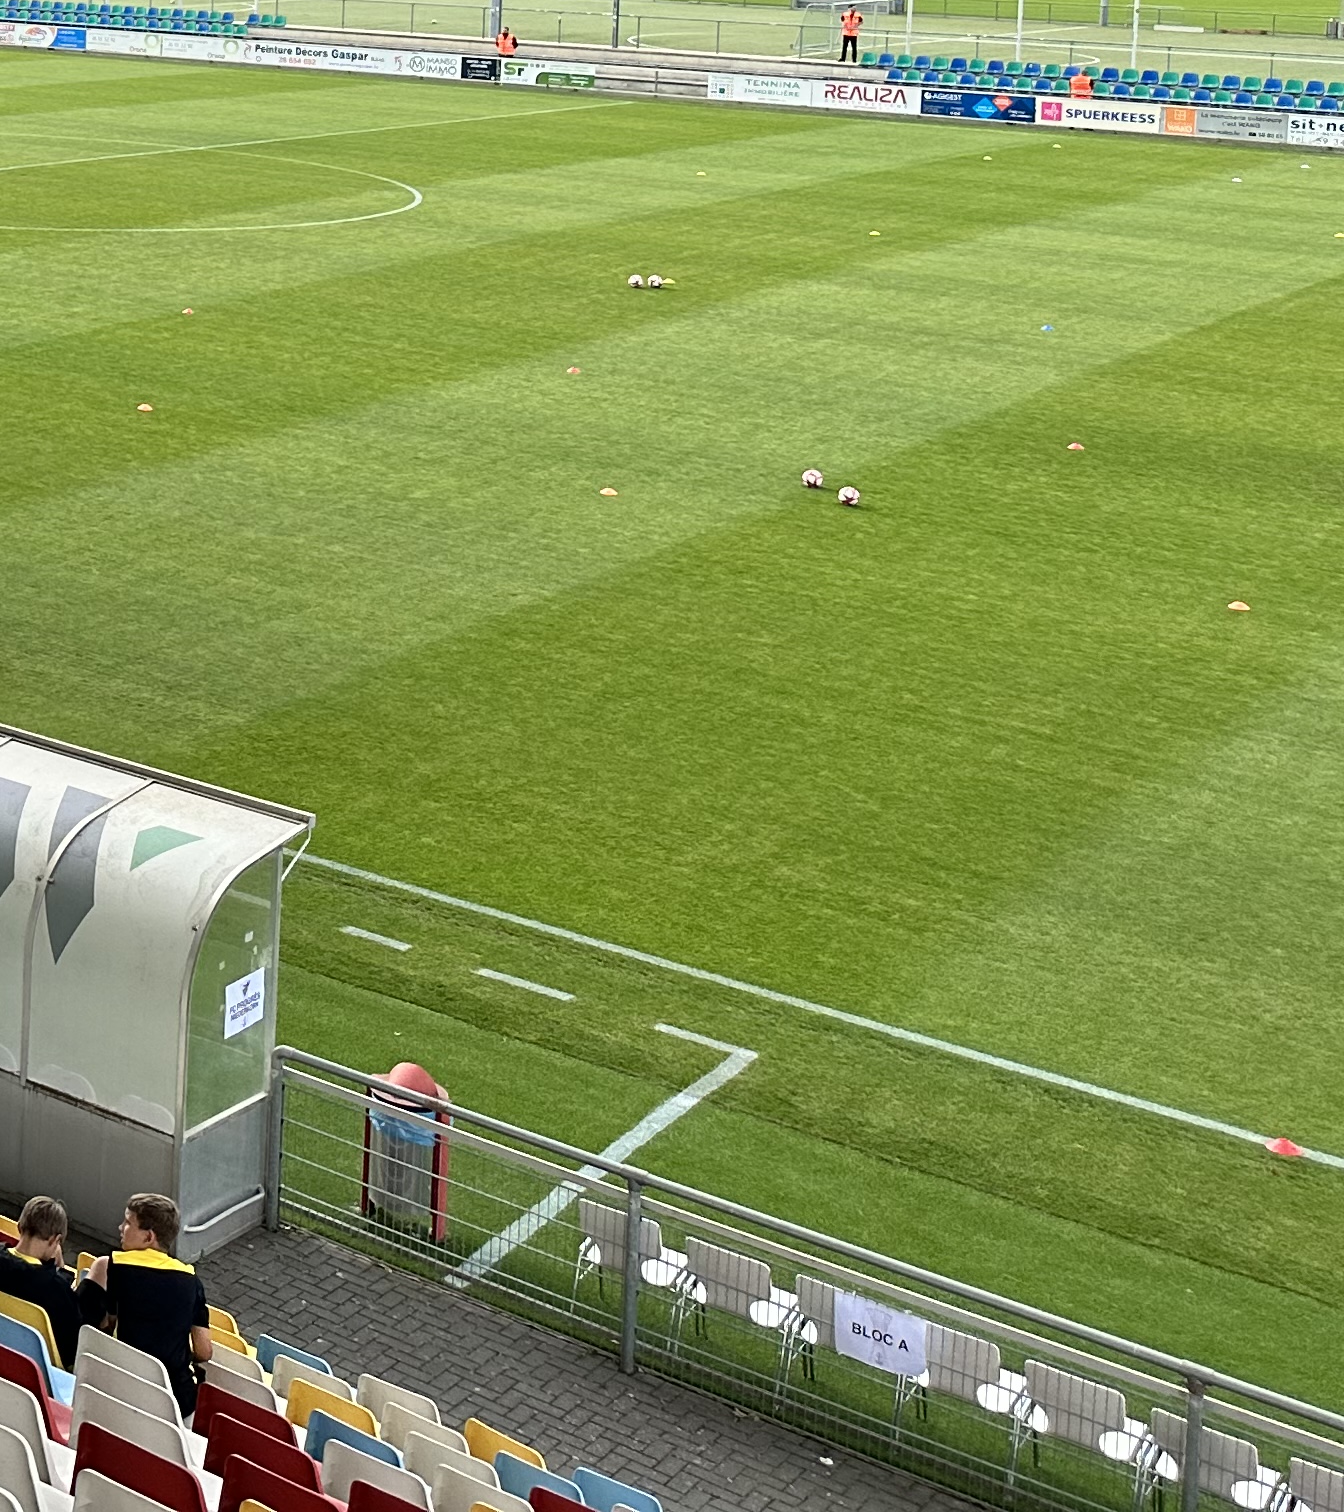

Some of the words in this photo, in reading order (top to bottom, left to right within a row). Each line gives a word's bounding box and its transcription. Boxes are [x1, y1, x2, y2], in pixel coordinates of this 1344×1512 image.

[255, 43, 293, 56] Peinture
[331, 49, 369, 62] Gaspar
[745, 78, 801, 89] TENNINA
[825, 83, 907, 105] REALIZA
[1065, 108, 1156, 124] SPUERKEESS
[851, 1321, 894, 1347] BLOC
[898, 1339, 909, 1353] A
